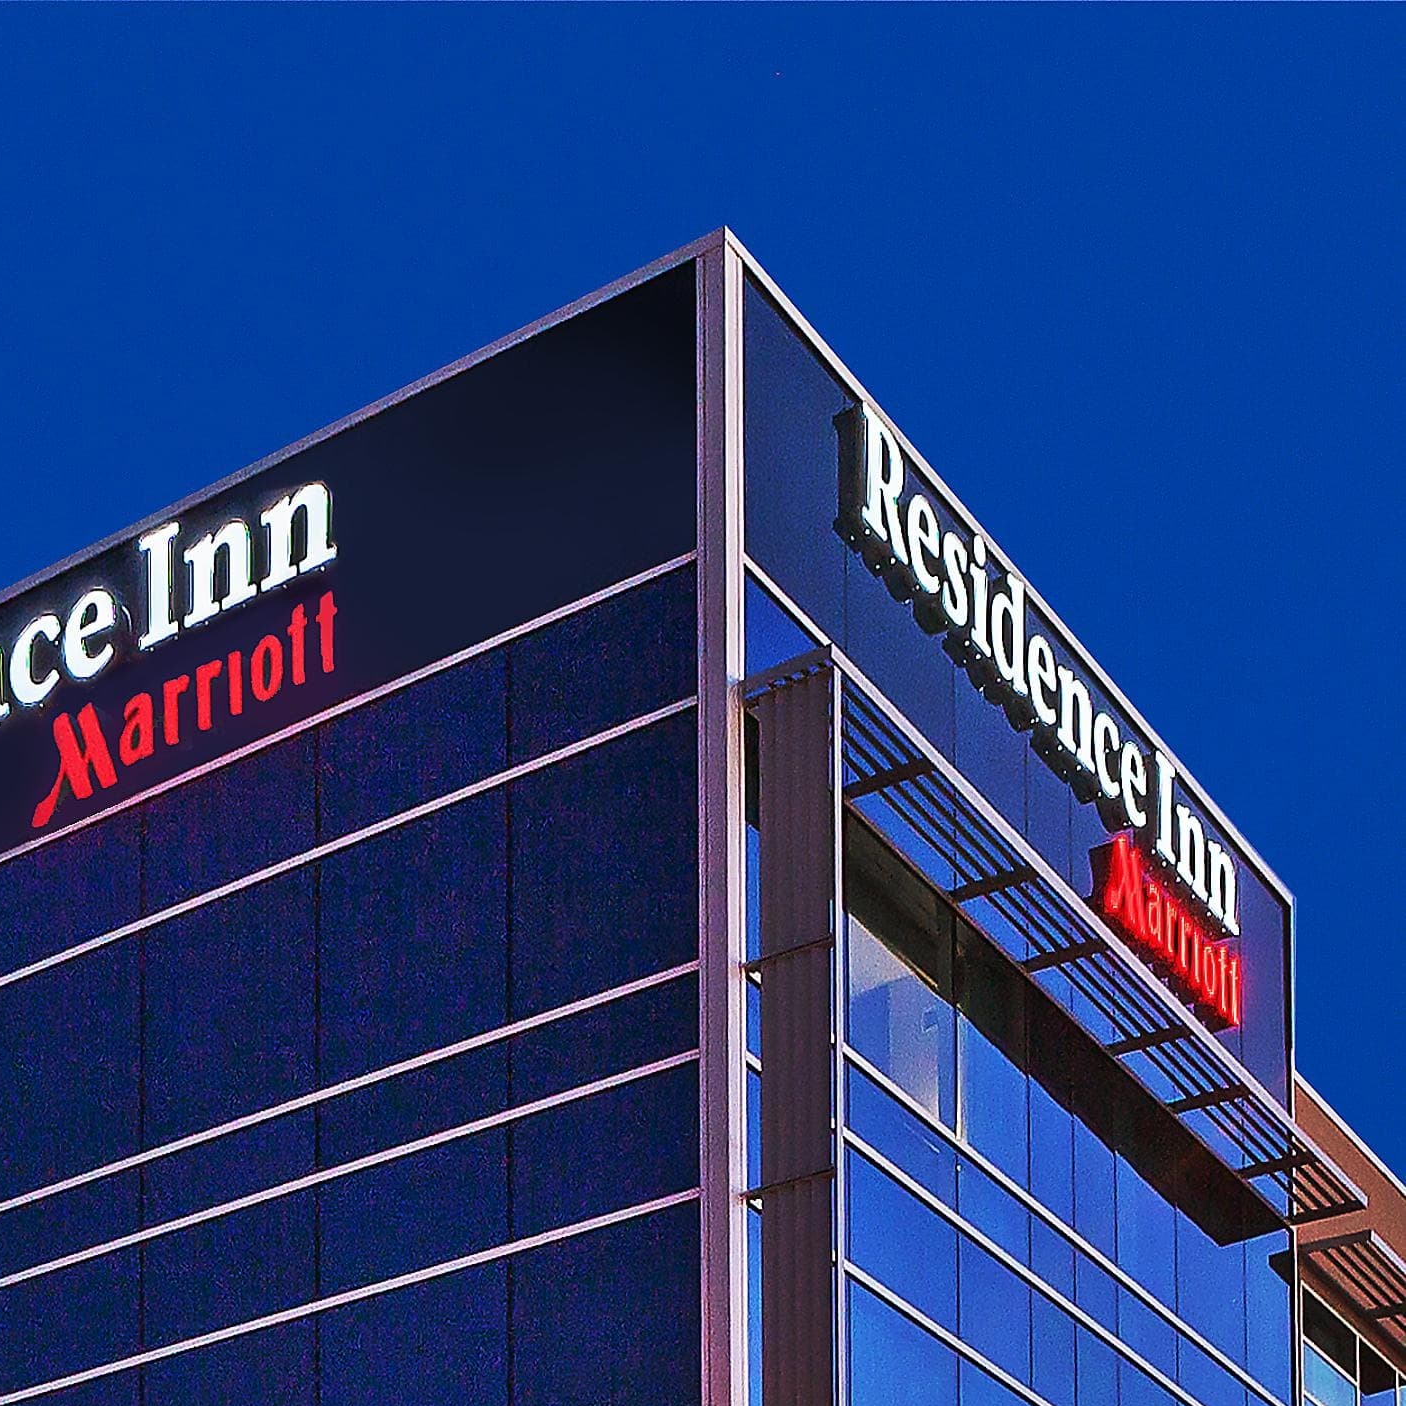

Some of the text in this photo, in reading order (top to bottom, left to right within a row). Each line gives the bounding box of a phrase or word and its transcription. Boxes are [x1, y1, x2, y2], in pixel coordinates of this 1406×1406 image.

[138, 482, 339, 652] Inn
[861, 402, 1240, 937] Residence Inn
[31, 590, 339, 828] Marriott
[1103, 834, 1242, 1026] Marriott
